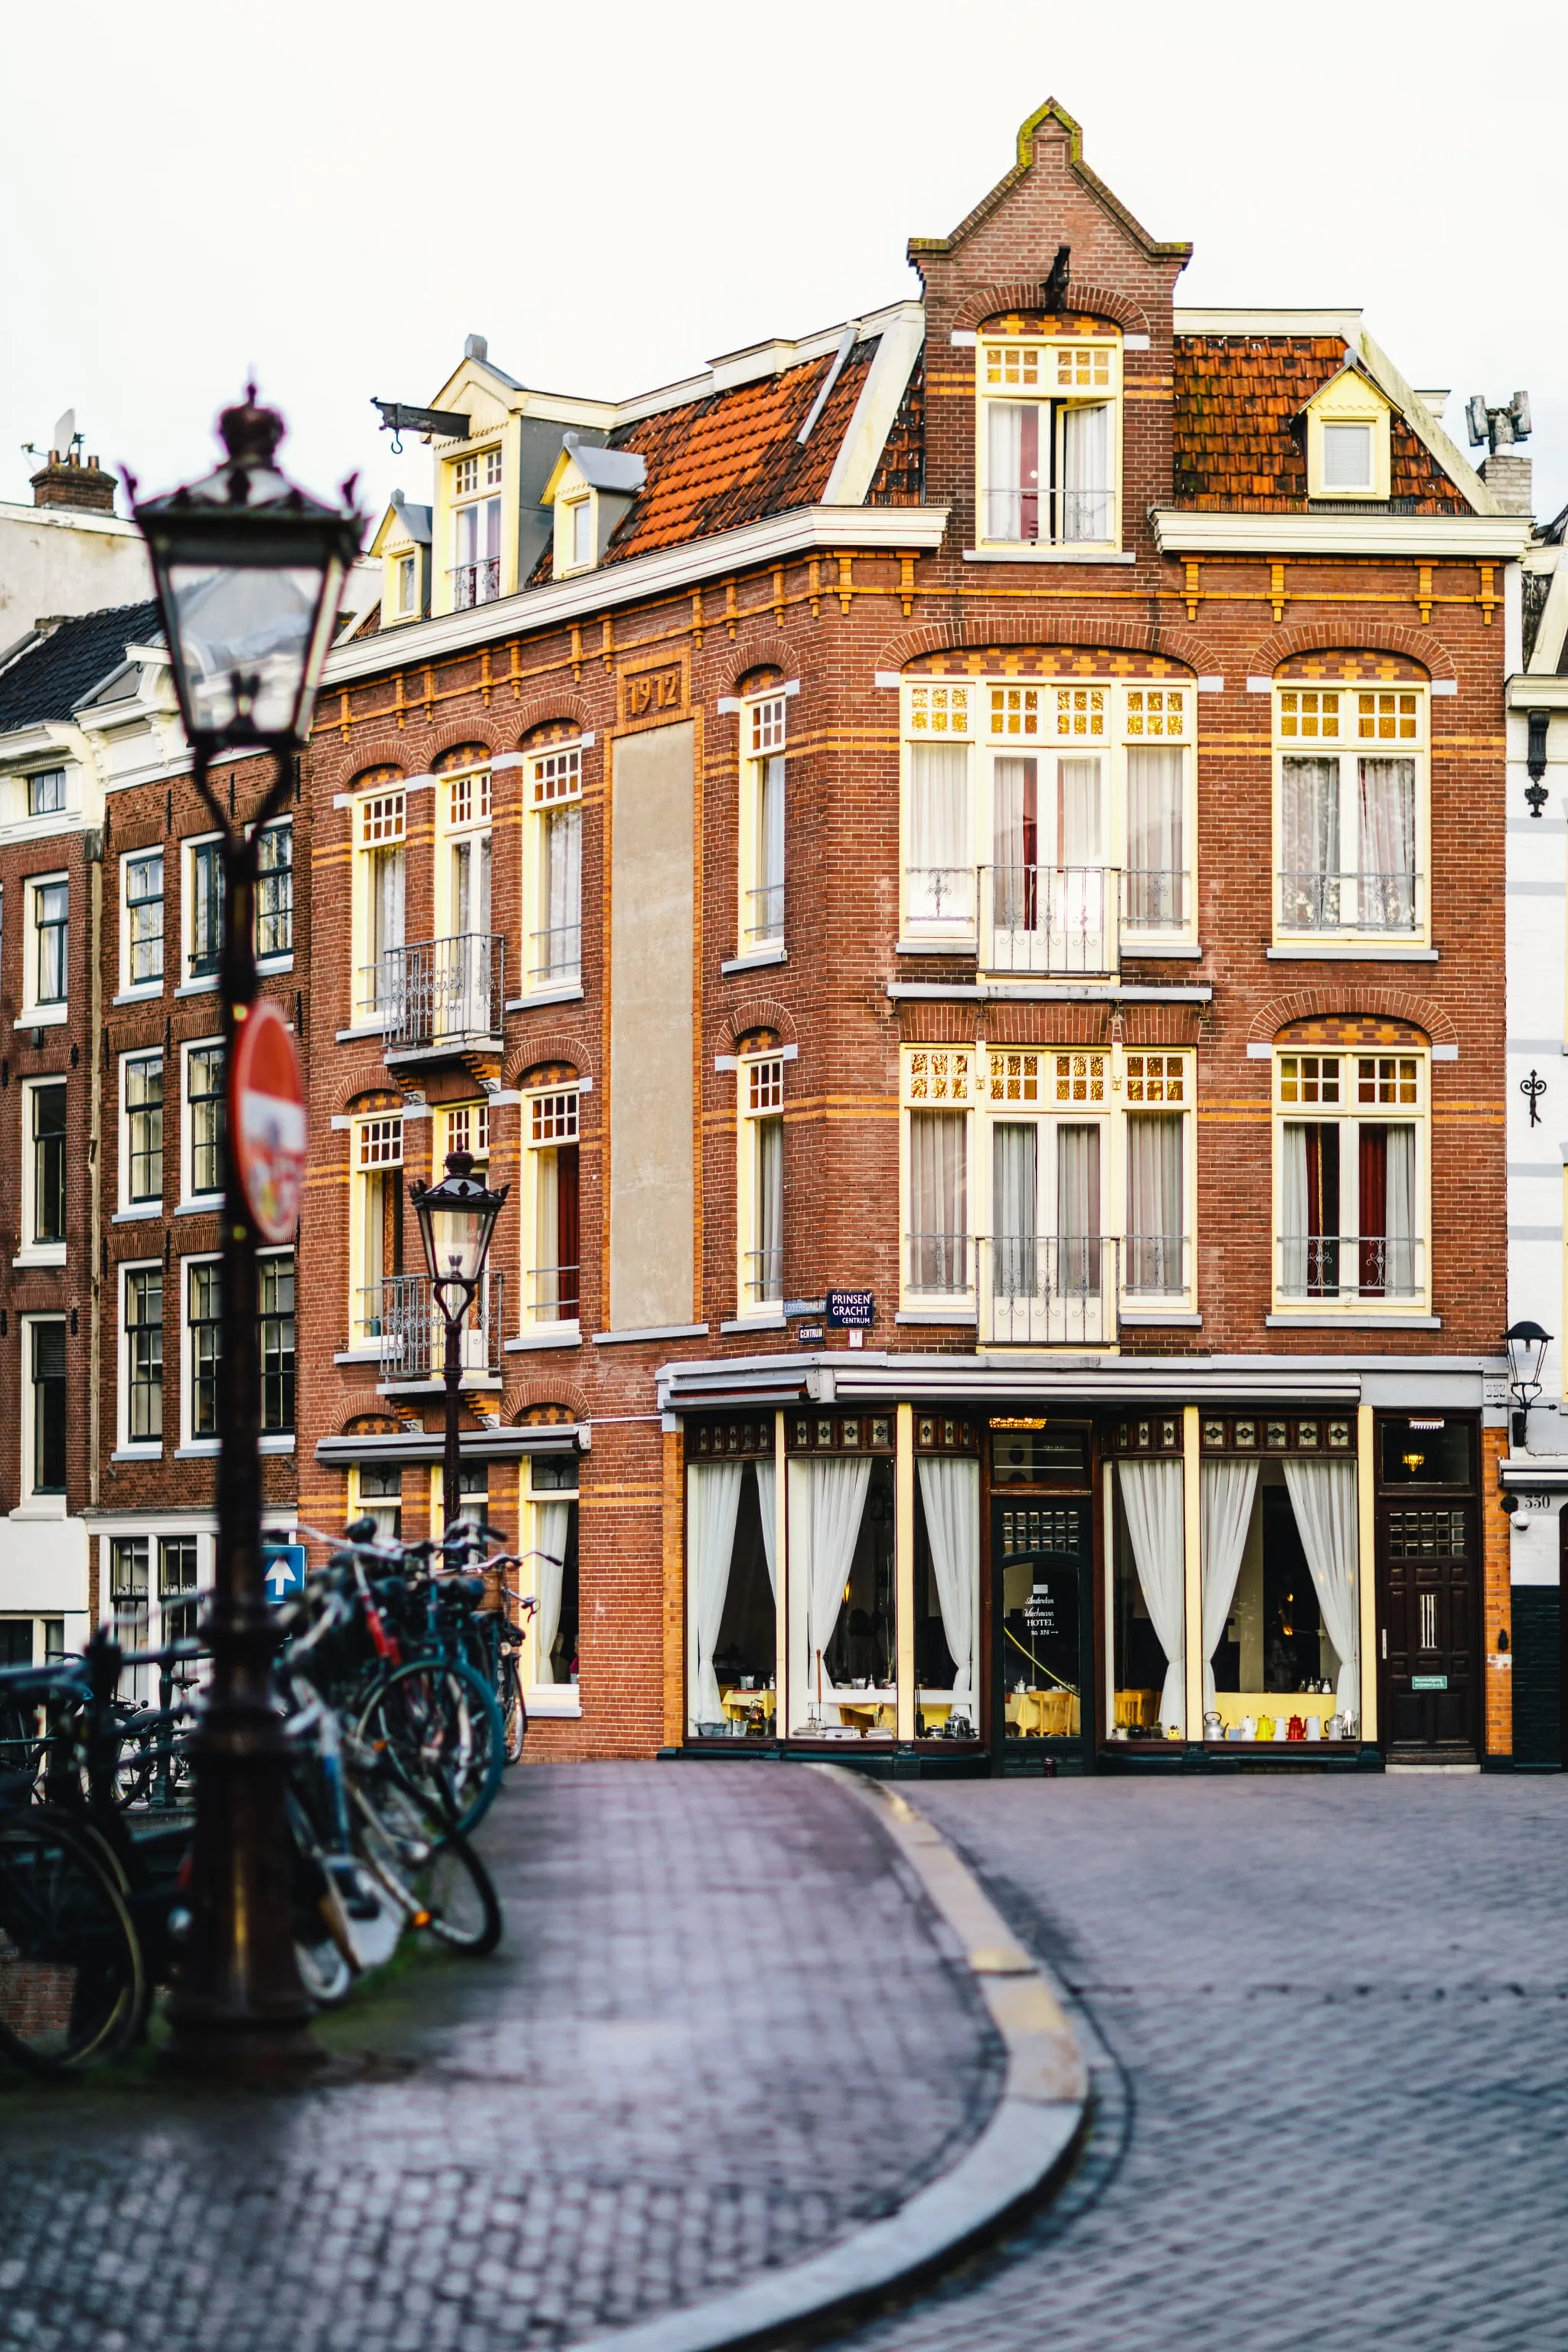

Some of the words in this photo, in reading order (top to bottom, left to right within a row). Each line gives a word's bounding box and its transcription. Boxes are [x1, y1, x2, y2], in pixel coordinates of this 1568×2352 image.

[627, 669, 678, 714] 1912
[832, 1294, 870, 1304] PRINSEN
[832, 1305, 869, 1315] GRACHT
[800, 1328, 823, 1339] CENTRUM
[1524, 1494, 1550, 1509] 330
[1024, 1595, 1054, 1605] Amsterdam
[1027, 1619, 1055, 1627] HOTEL
